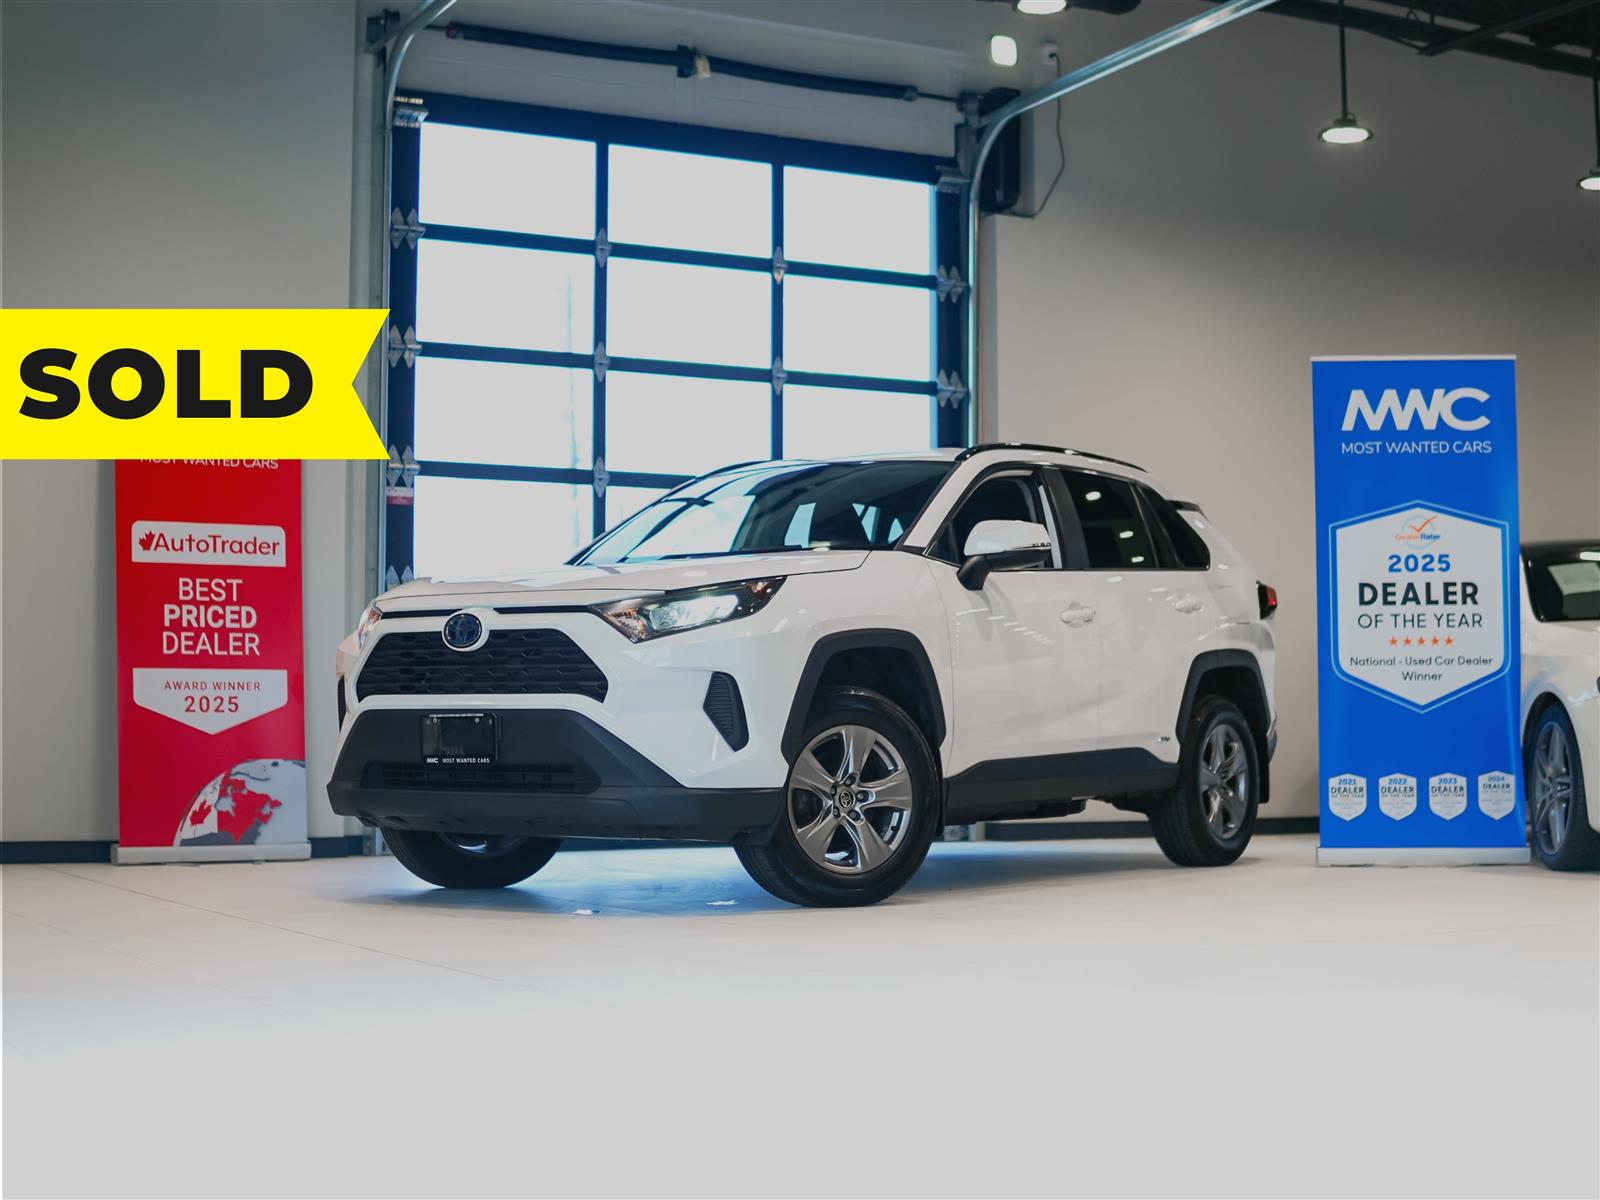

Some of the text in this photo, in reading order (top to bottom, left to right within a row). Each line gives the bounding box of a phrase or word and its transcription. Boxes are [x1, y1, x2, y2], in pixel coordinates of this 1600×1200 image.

[1341, 387, 1491, 431] MWC
[1341, 440, 1492, 454] MOST WANTED CARS
[153, 532, 280, 556] AutoTrader
[1387, 553, 1451, 573] 2025
[178, 577, 243, 602] BEST
[1358, 582, 1479, 606] DEALER
[163, 603, 258, 629] PRICED
[1357, 612, 1483, 629] OF THE YEAR
[162, 631, 260, 656] DEALER
[1350, 656, 1396, 667] National
[1404, 656, 1432, 666] Used
[1434, 655, 1454, 666] Car
[1457, 655, 1493, 666] Dealer
[1401, 671, 1443, 681] Winner
[163, 680, 261, 692] AWARD WINNER
[184, 695, 240, 713] 2025
[1331, 786, 1364, 794] DEALER
[1381, 786, 1415, 794] DEALER
[1431, 785, 1464, 793] DEALER
